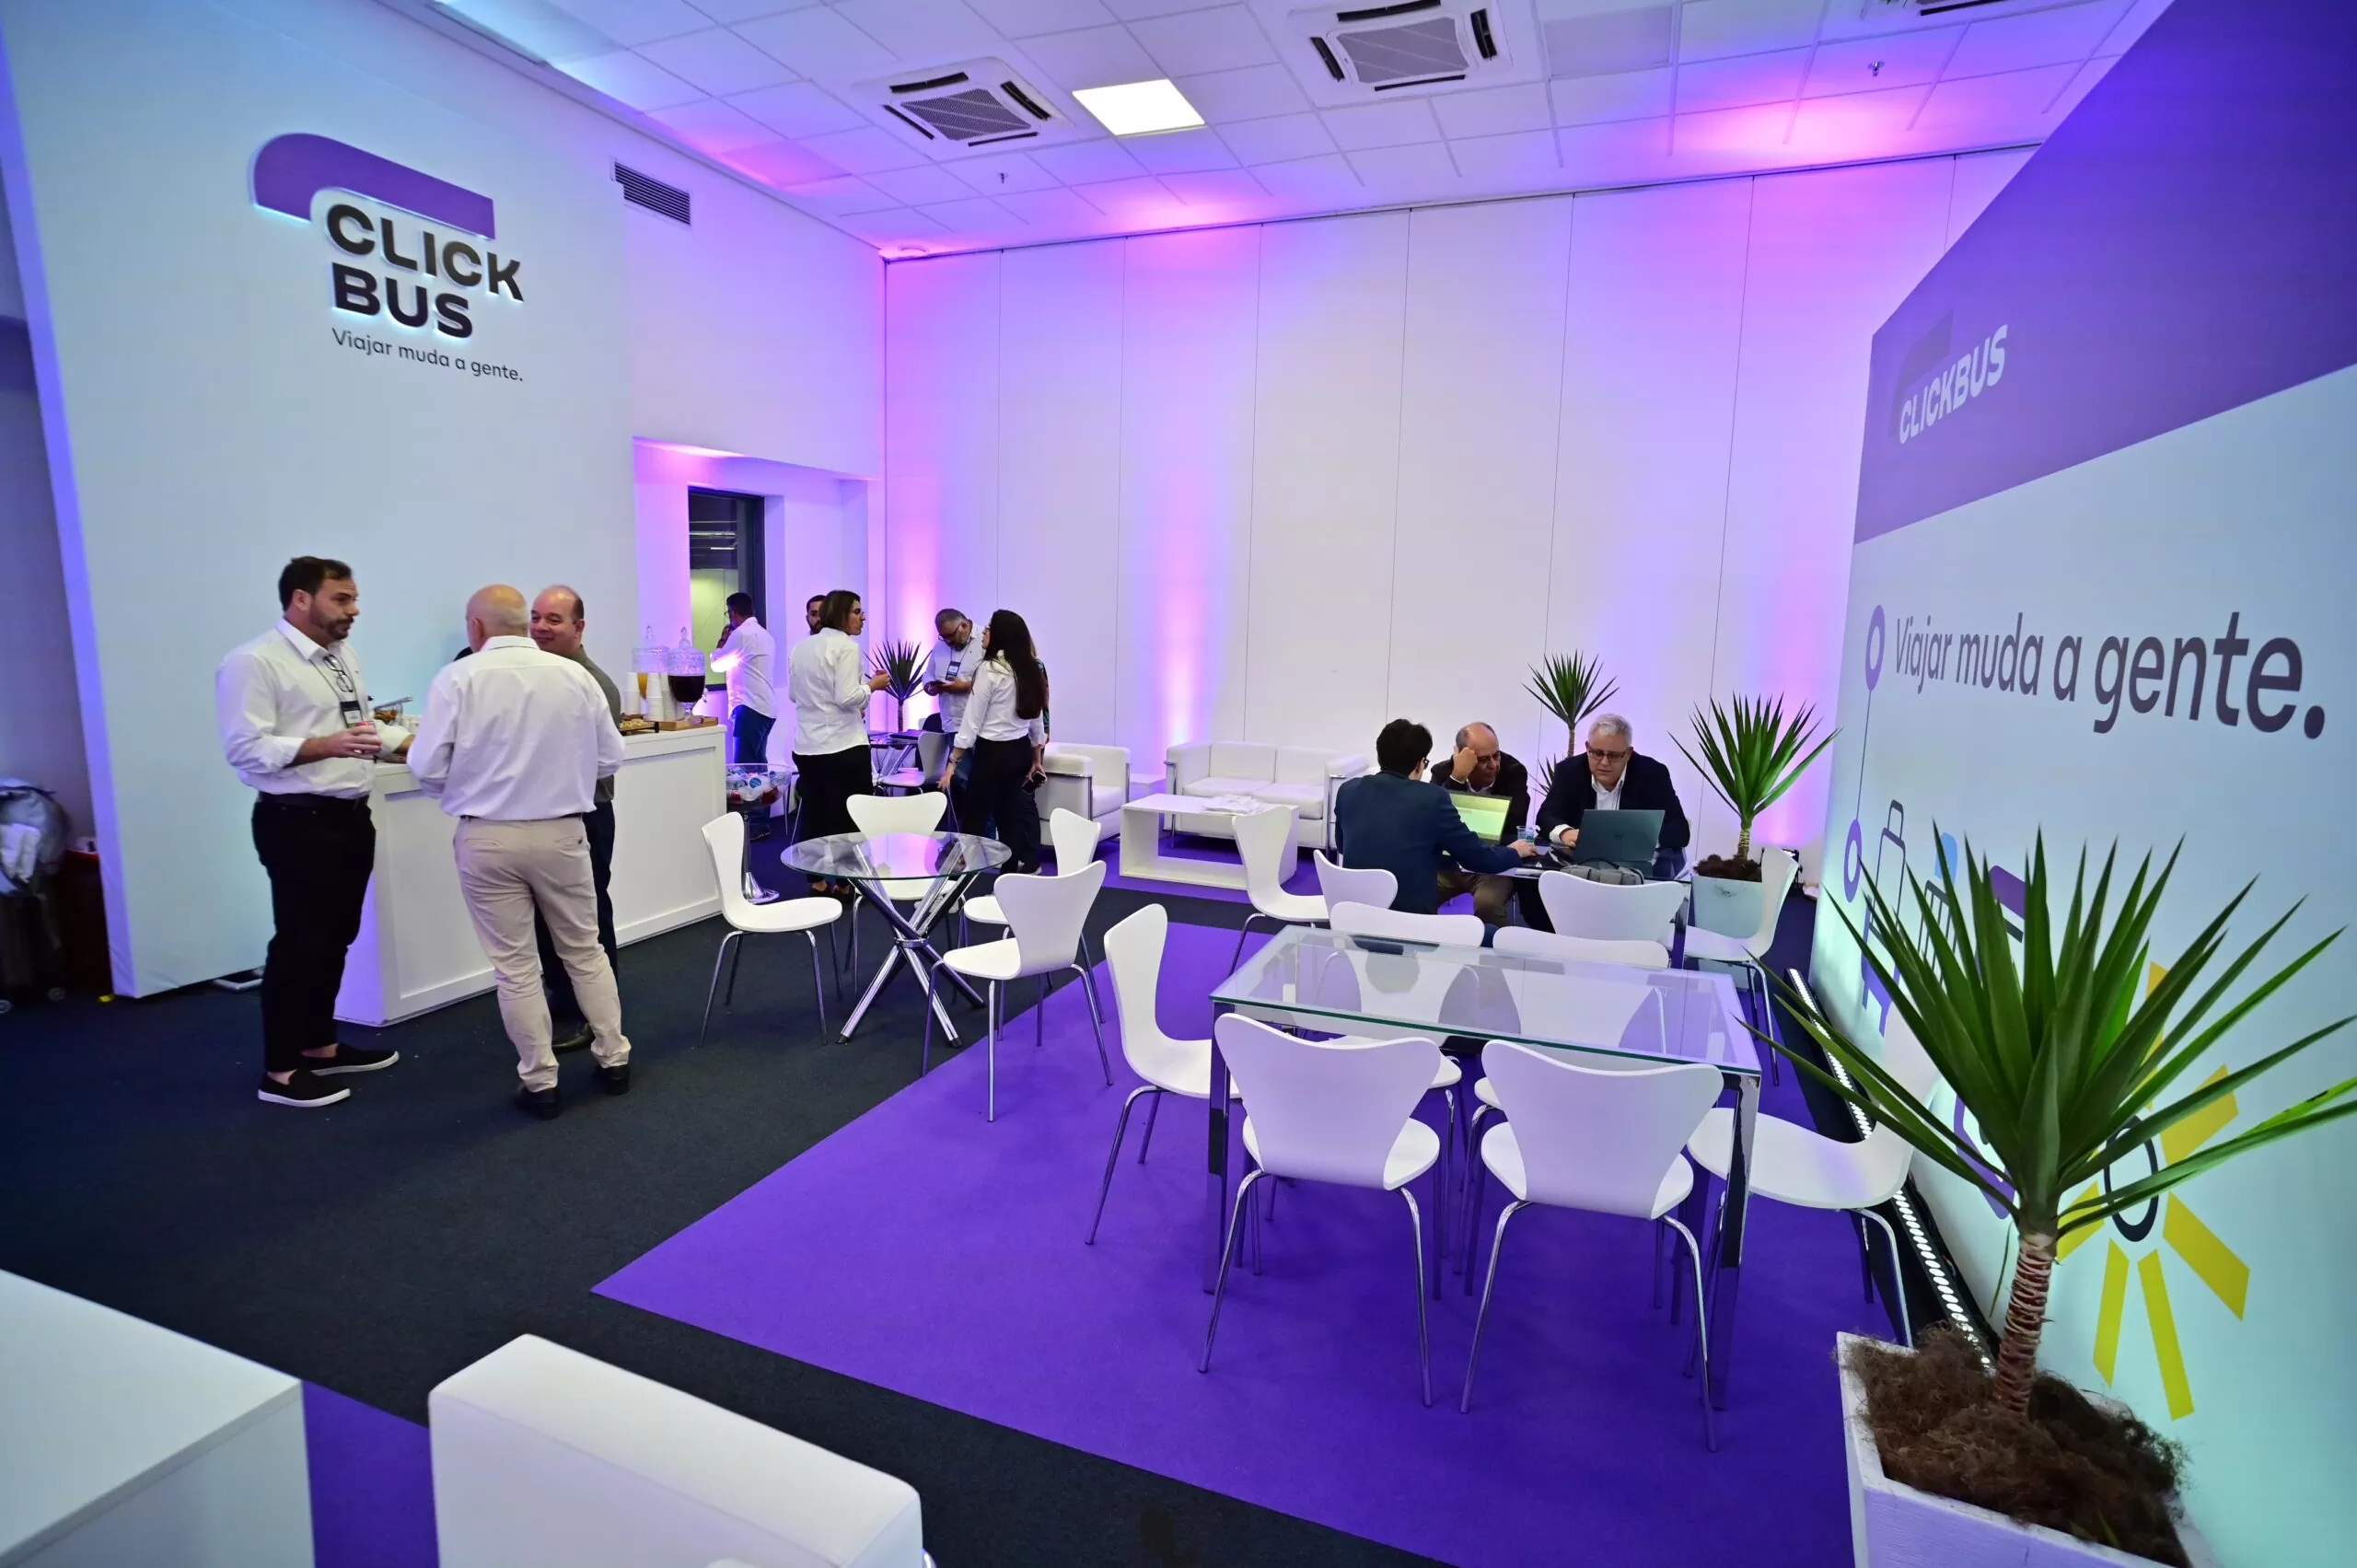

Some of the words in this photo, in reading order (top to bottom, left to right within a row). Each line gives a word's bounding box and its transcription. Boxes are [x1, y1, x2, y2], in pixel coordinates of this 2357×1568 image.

[327, 203, 524, 302] CLICK
[331, 261, 473, 339] BUS
[331, 328, 392, 355] Viajar
[399, 345, 450, 367] muda
[455, 357, 466, 370] a
[470, 361, 524, 382] gente.
[1898, 324, 2008, 445] CLICKBUS
[1896, 615, 1953, 694] Viajar
[1956, 612, 2044, 696] muda
[2053, 635, 2083, 702] a
[2093, 611, 2326, 740] gente.
